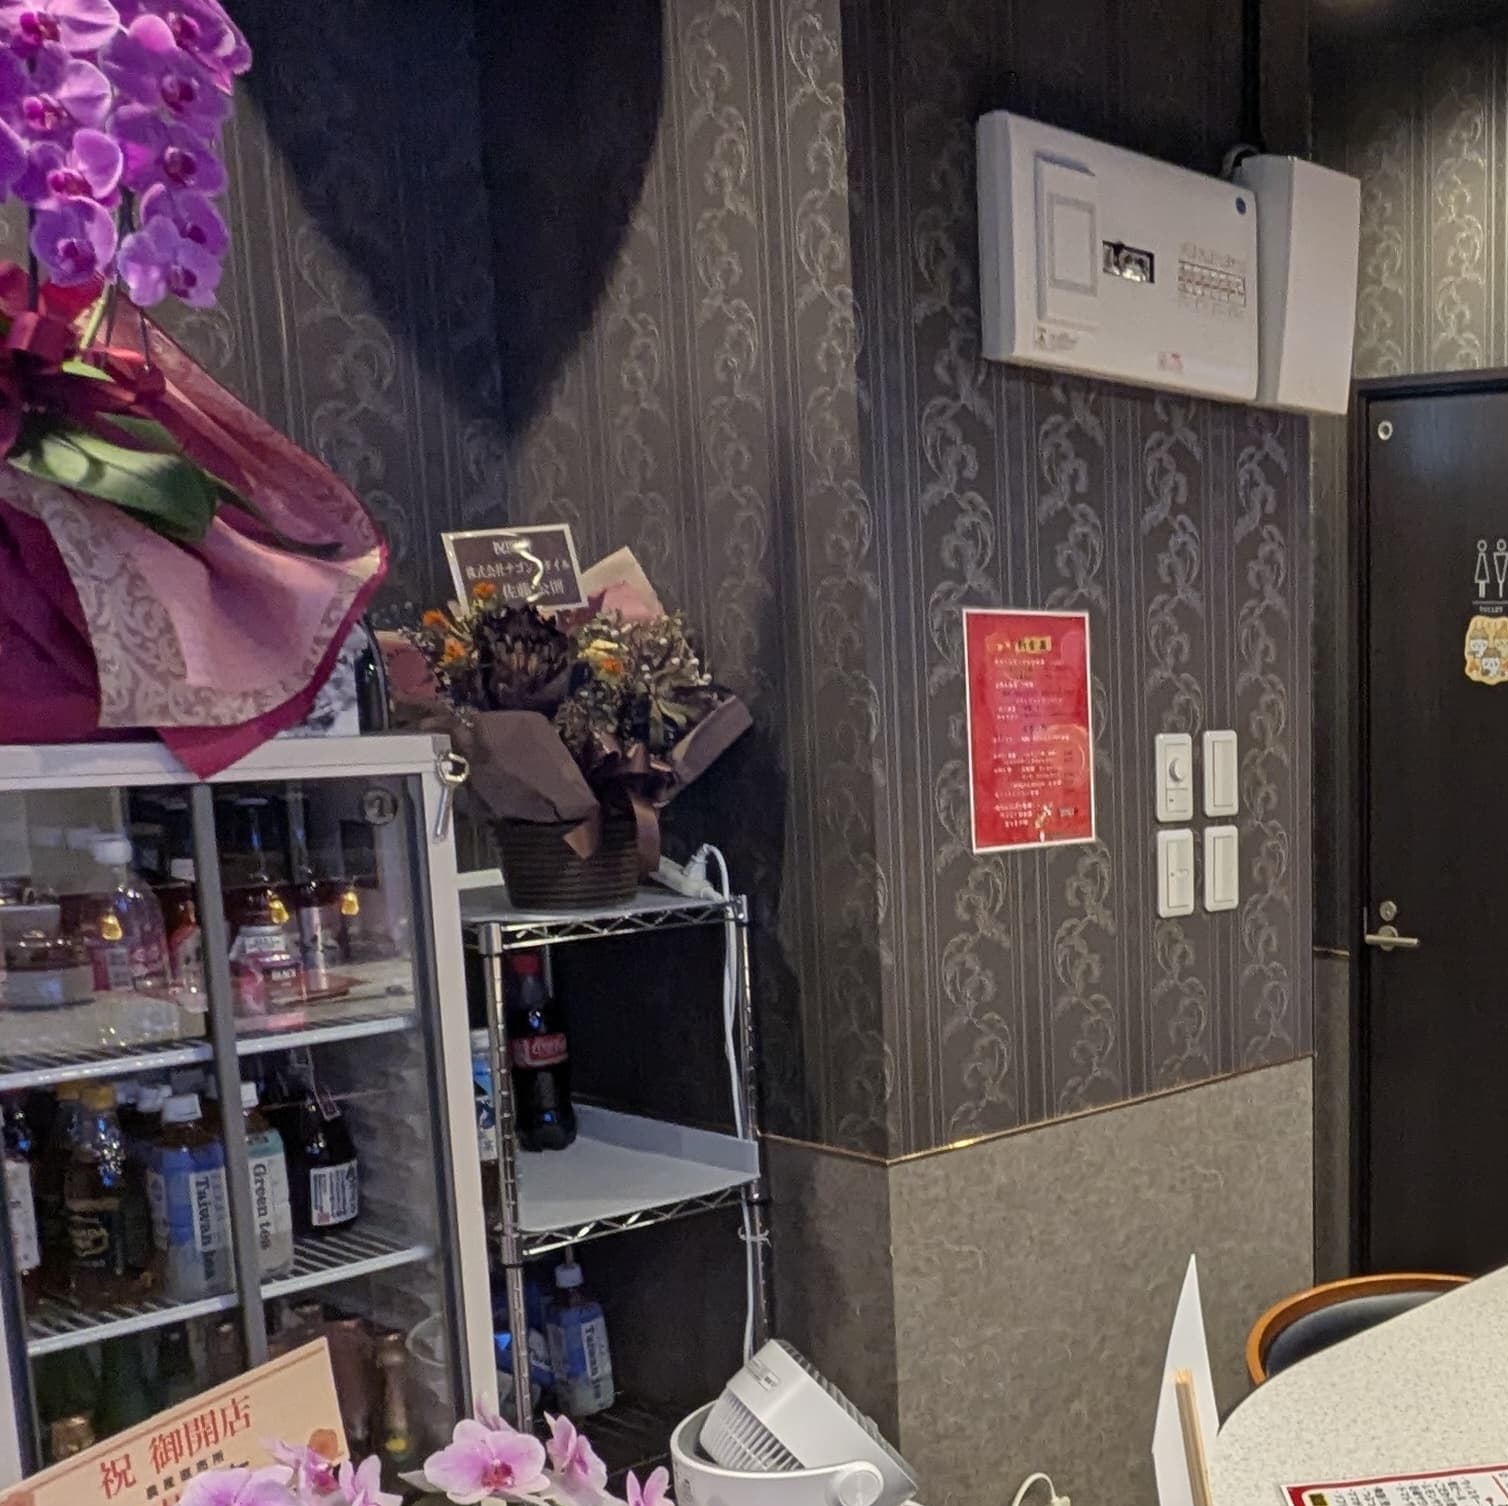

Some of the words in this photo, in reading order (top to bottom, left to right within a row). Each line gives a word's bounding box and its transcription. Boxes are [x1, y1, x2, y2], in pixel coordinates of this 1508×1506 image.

[100, 1453, 137, 1499] 祝
[149, 1395, 251, 1474] 御開店
